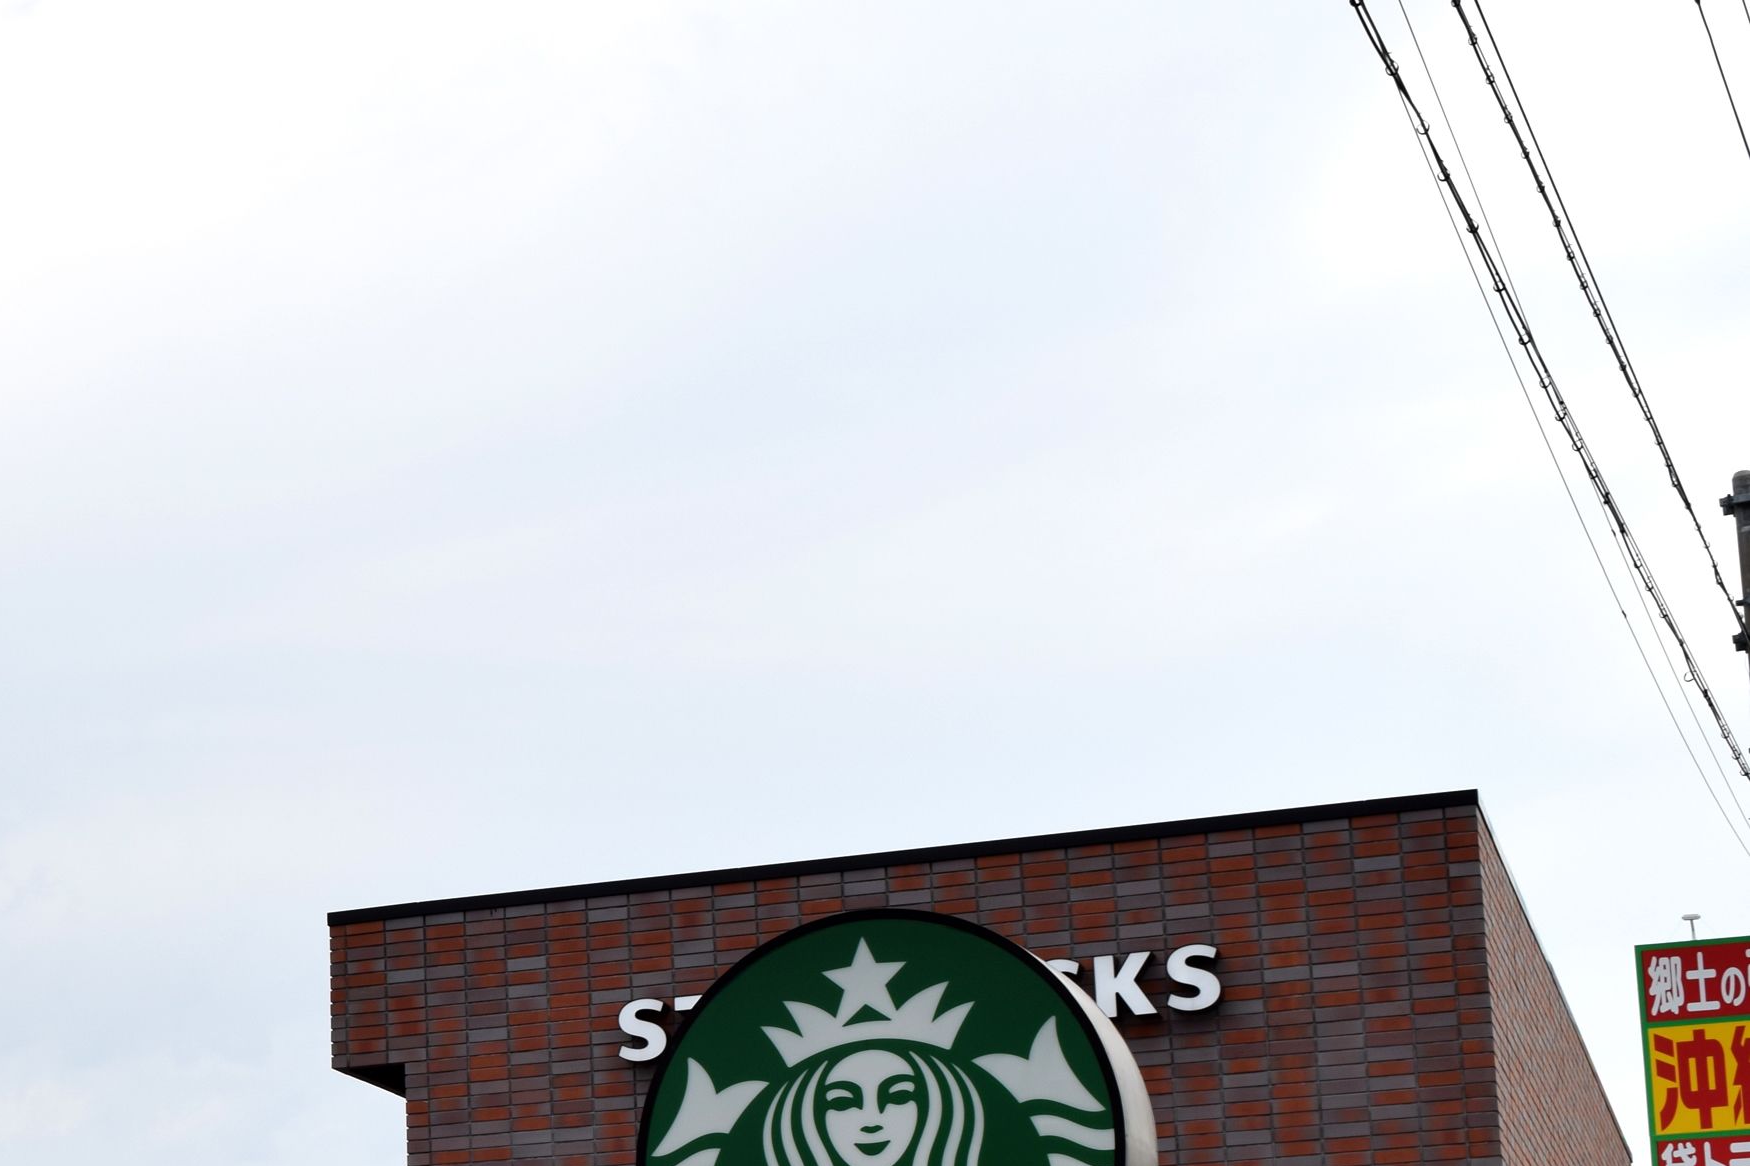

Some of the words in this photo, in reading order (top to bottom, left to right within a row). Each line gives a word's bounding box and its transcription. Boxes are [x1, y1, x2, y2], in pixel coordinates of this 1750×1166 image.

[1648, 949, 1750, 1016] 郷土の
[1653, 1025, 1750, 1132] 沖
